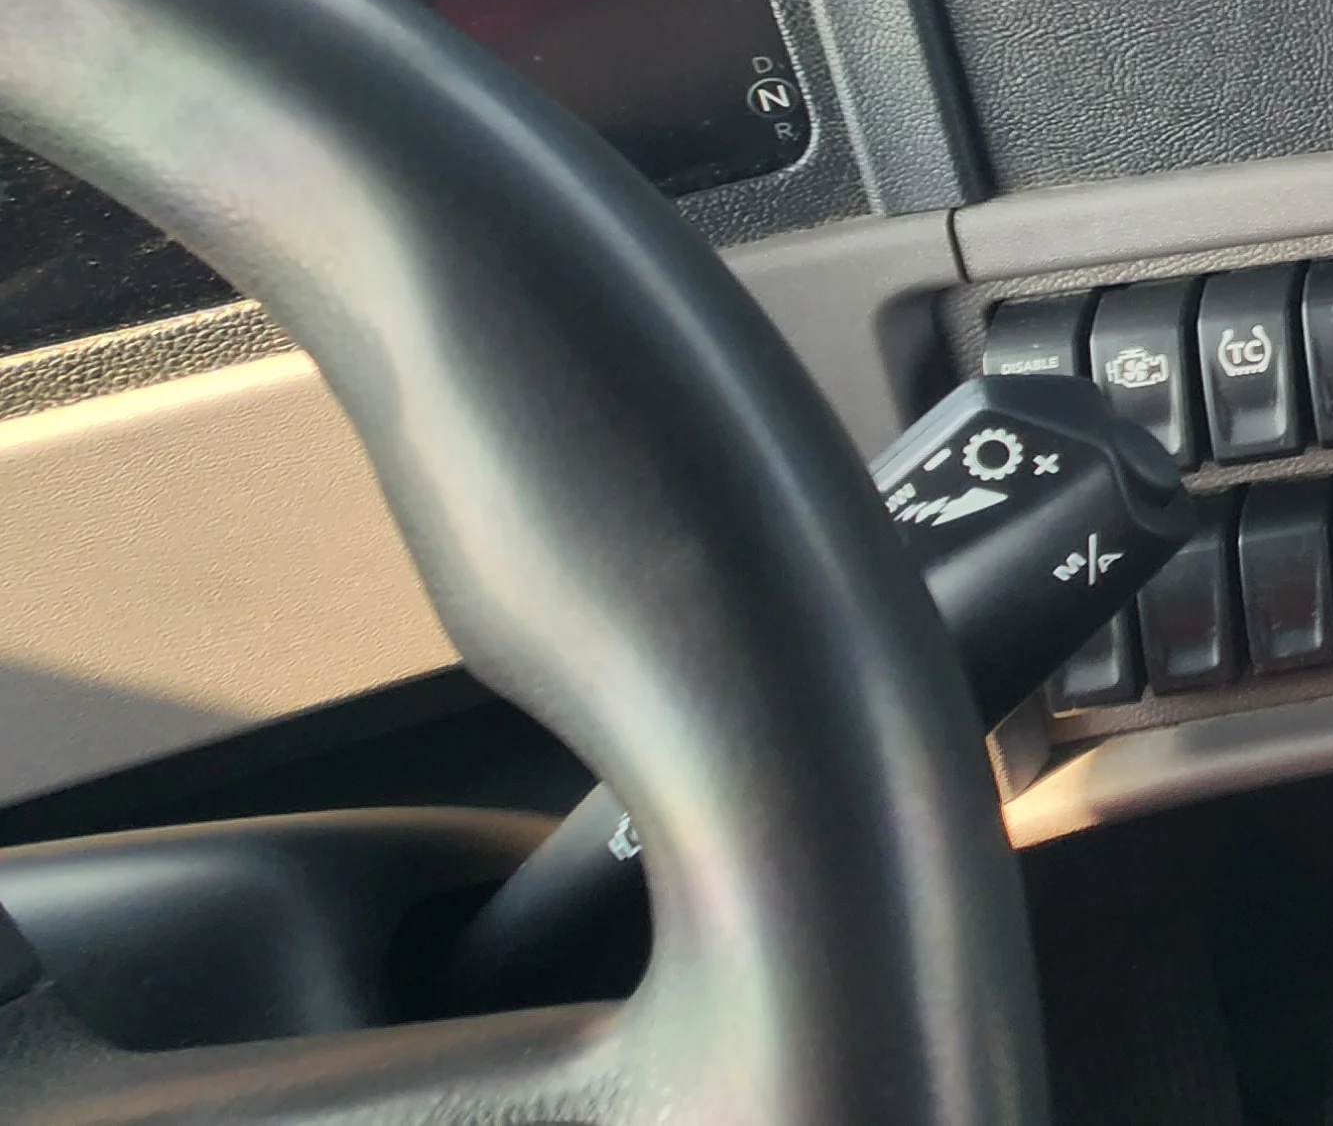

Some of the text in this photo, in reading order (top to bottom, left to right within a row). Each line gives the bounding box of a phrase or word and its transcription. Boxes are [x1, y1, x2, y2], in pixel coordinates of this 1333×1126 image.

[752, 56, 774, 74] D
[757, 85, 790, 112] N
[774, 122, 794, 140] R
[1226, 339, 1264, 364] TC
[1000, 355, 1060, 375] DISABLE
